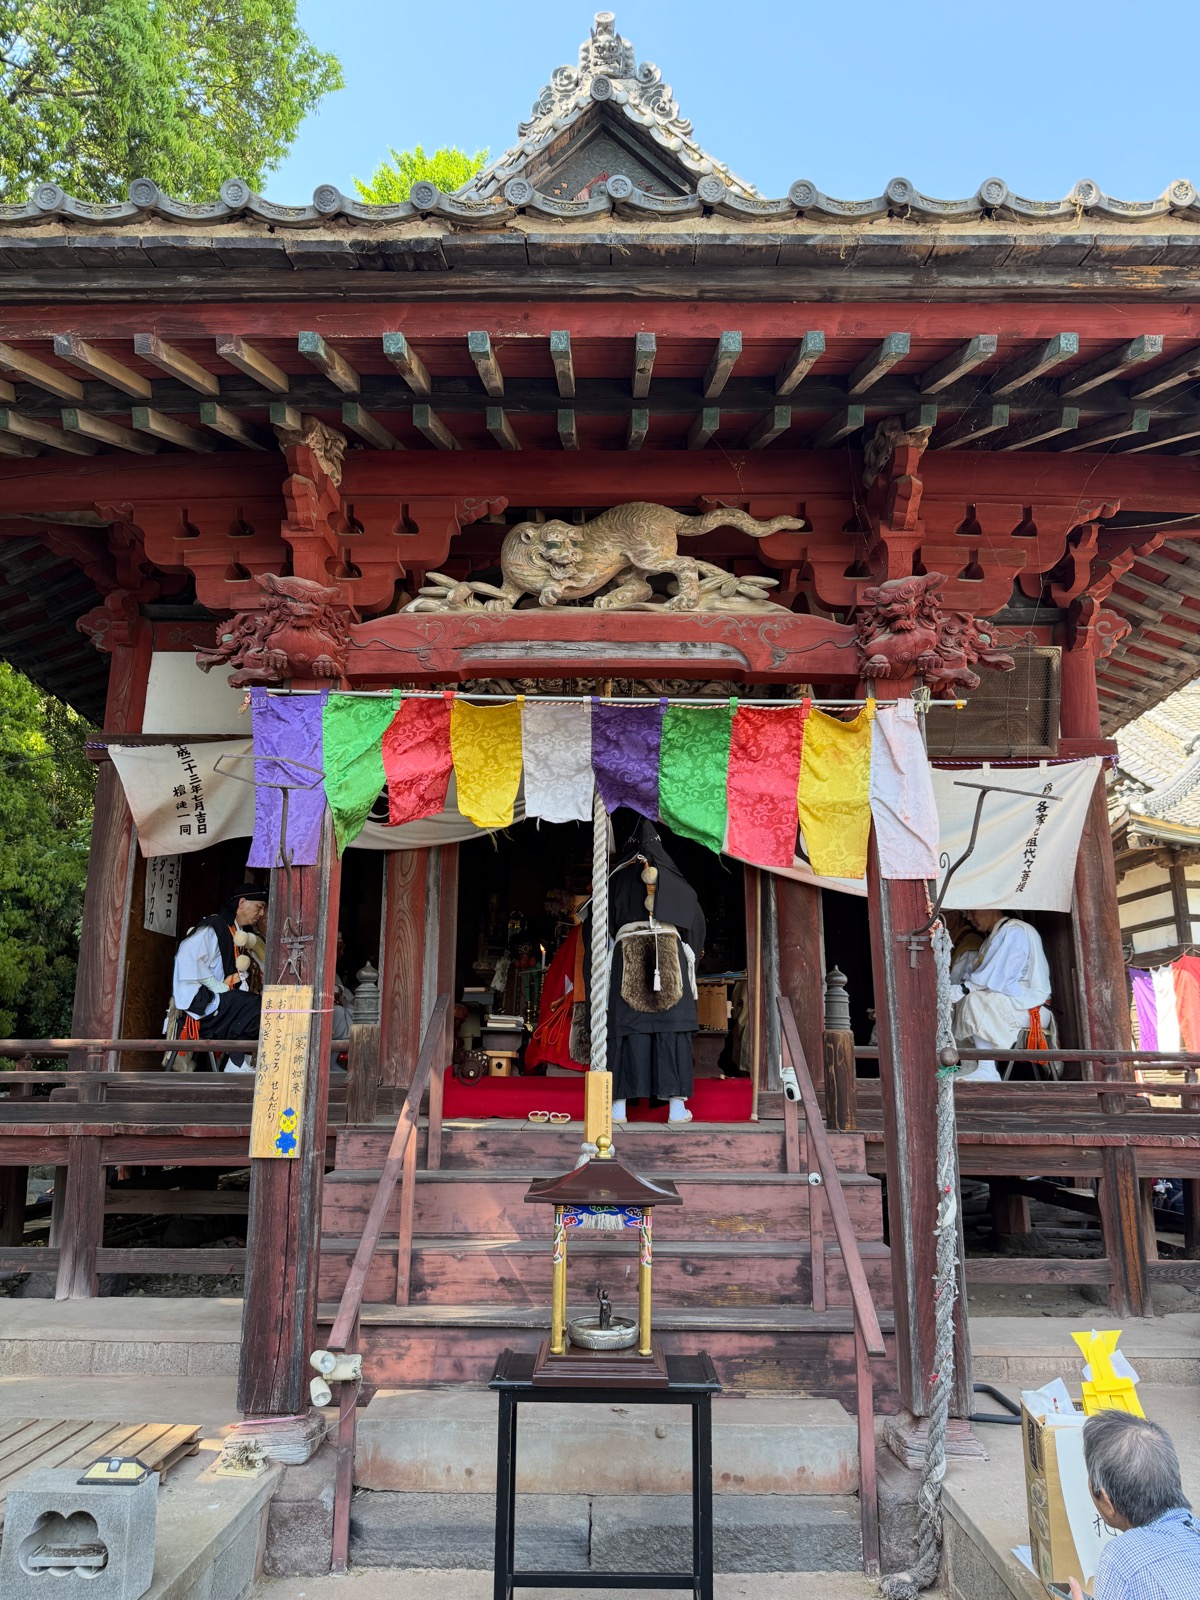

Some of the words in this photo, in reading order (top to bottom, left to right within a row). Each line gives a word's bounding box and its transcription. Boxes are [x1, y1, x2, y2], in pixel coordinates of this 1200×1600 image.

[172, 784, 191, 836] 檀徒一同
[272, 1028, 282, 1073] ころころ
[268, 1081, 279, 1123] せんだり
